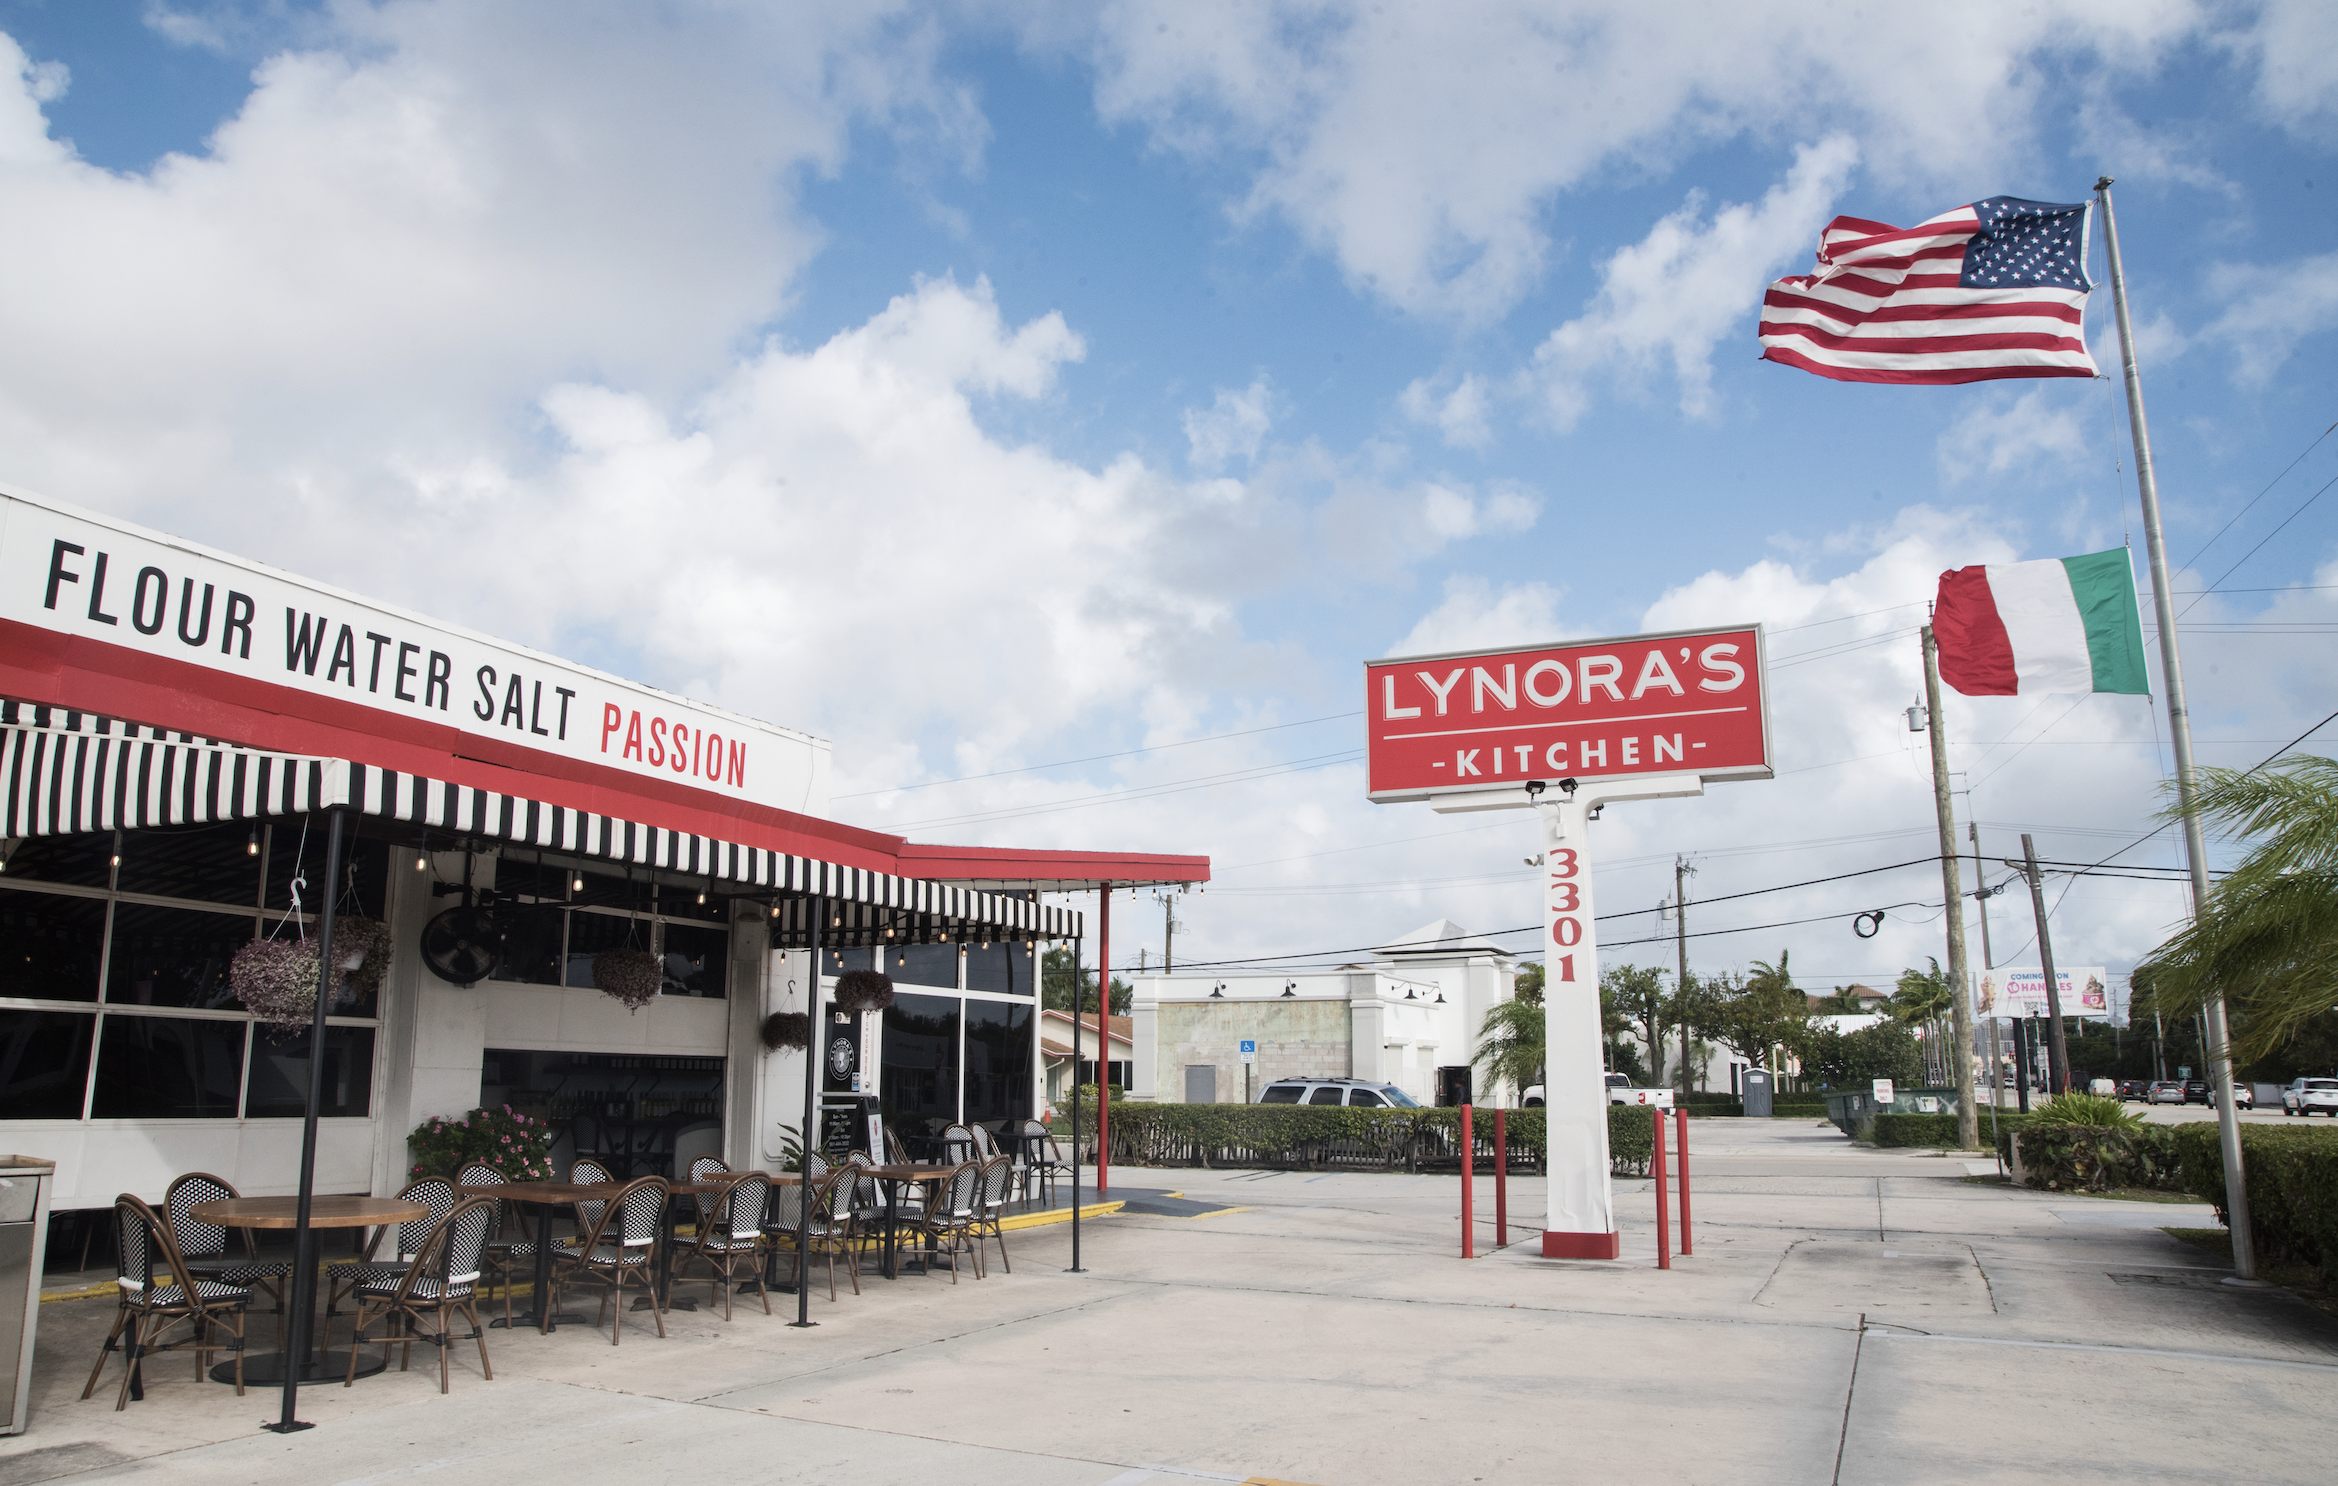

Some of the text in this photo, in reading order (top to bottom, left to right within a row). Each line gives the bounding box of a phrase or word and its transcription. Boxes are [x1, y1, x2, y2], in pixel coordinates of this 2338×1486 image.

[44, 539, 747, 789] FLOUR WATER SALT PASSION
[1381, 642, 1747, 721] LYNORA'S
[1549, 848, 1582, 983] 3301
[2007, 982, 2073, 993] 16 HANES
